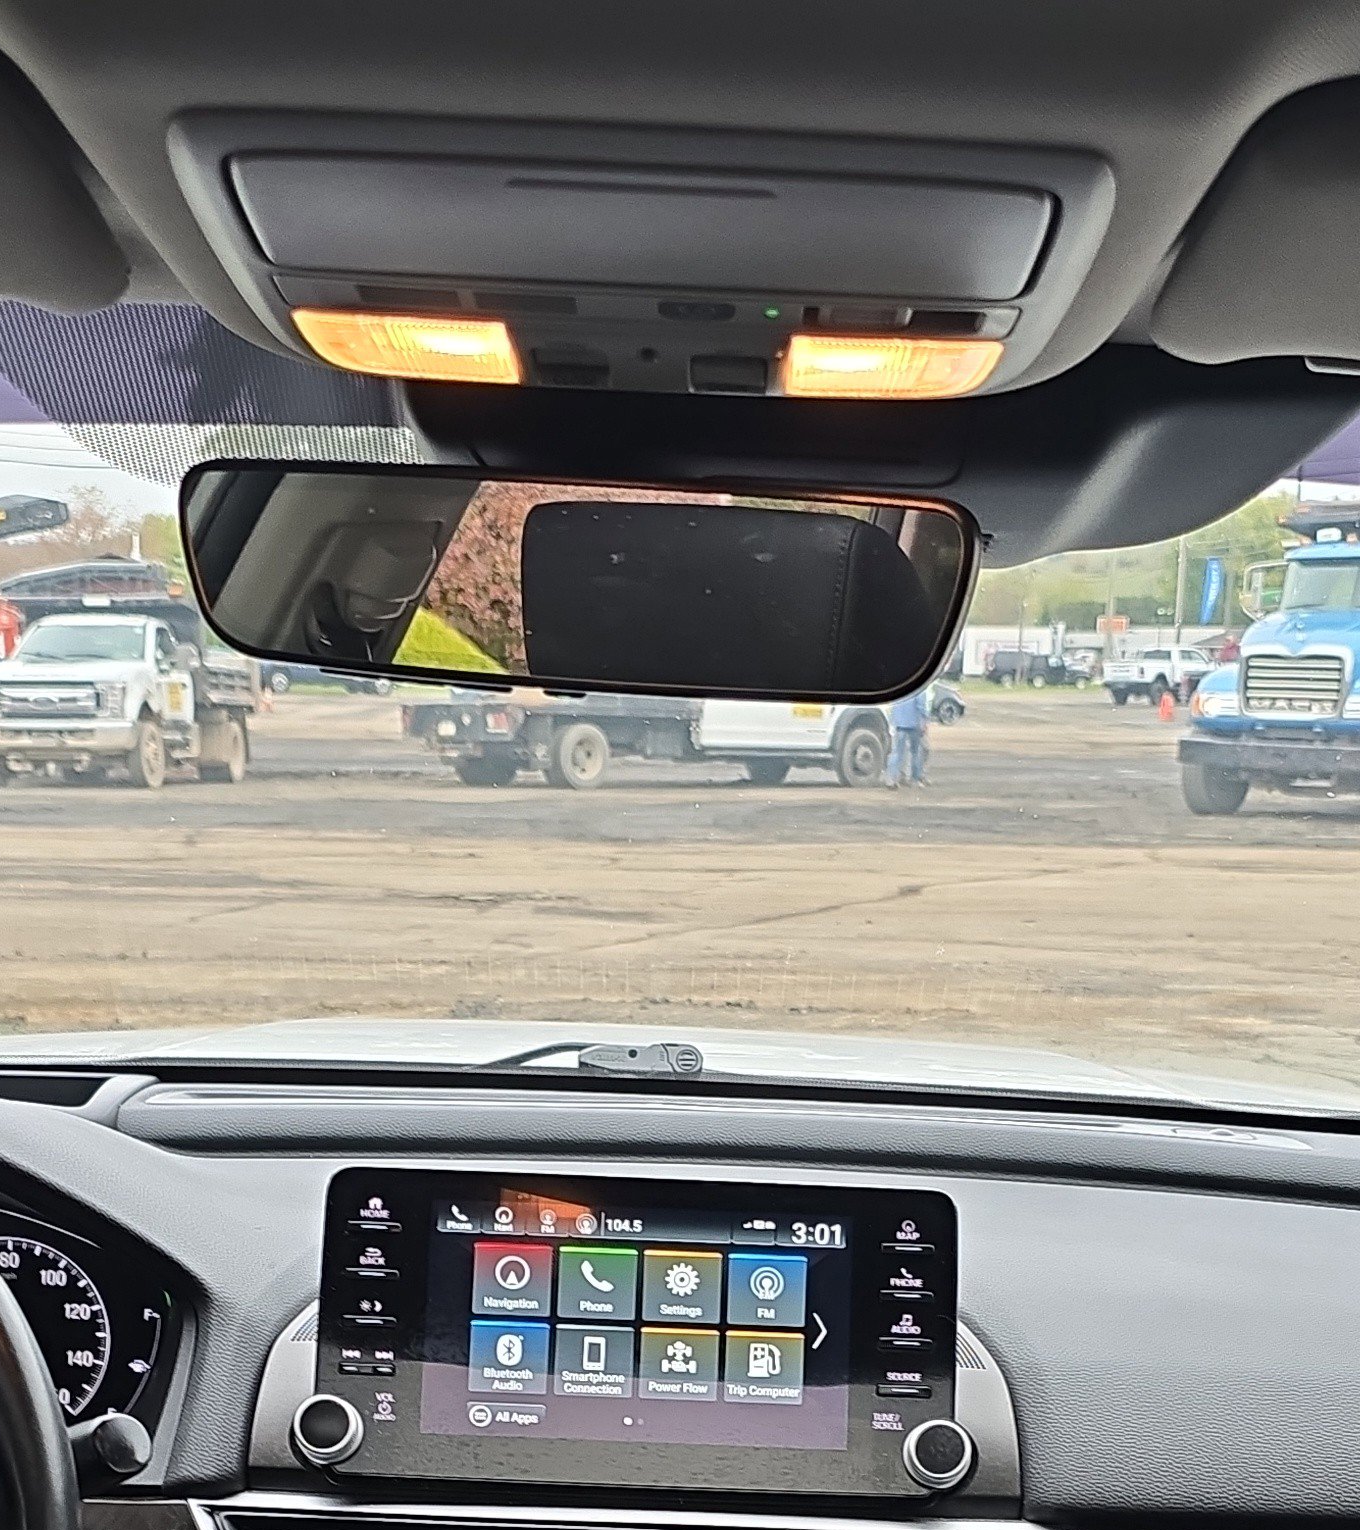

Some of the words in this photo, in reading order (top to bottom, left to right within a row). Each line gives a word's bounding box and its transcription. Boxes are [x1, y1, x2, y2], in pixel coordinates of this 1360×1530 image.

[359, 1208, 391, 1219] HOME
[446, 1219, 473, 1231] Phone
[605, 1219, 643, 1233] 104.5
[791, 1222, 843, 1246] 3:01
[896, 1230, 921, 1240] MAP
[359, 1255, 386, 1266] BACK
[40, 1269, 67, 1287] 100
[889, 1277, 924, 1288] PHONE
[483, 1296, 539, 1310] Navigation
[579, 1300, 614, 1313] Phone
[64, 1303, 91, 1321] 120
[659, 1303, 703, 1318] Settings
[757, 1308, 776, 1320] FM
[890, 1325, 922, 1335] AUDIO
[66, 1350, 94, 1368] 140
[483, 1367, 534, 1380] Bluetooth
[561, 1370, 626, 1384] Smartphone
[886, 1371, 923, 1382] SOURCE
[492, 1380, 523, 1391] Audio
[563, 1383, 622, 1395] Connection
[648, 1381, 682, 1394] Power
[683, 1382, 708, 1394] Flow
[727, 1384, 747, 1398] Trip
[748, 1385, 800, 1399] Computer
[495, 1411, 510, 1423] All
[510, 1412, 539, 1426] Apps
